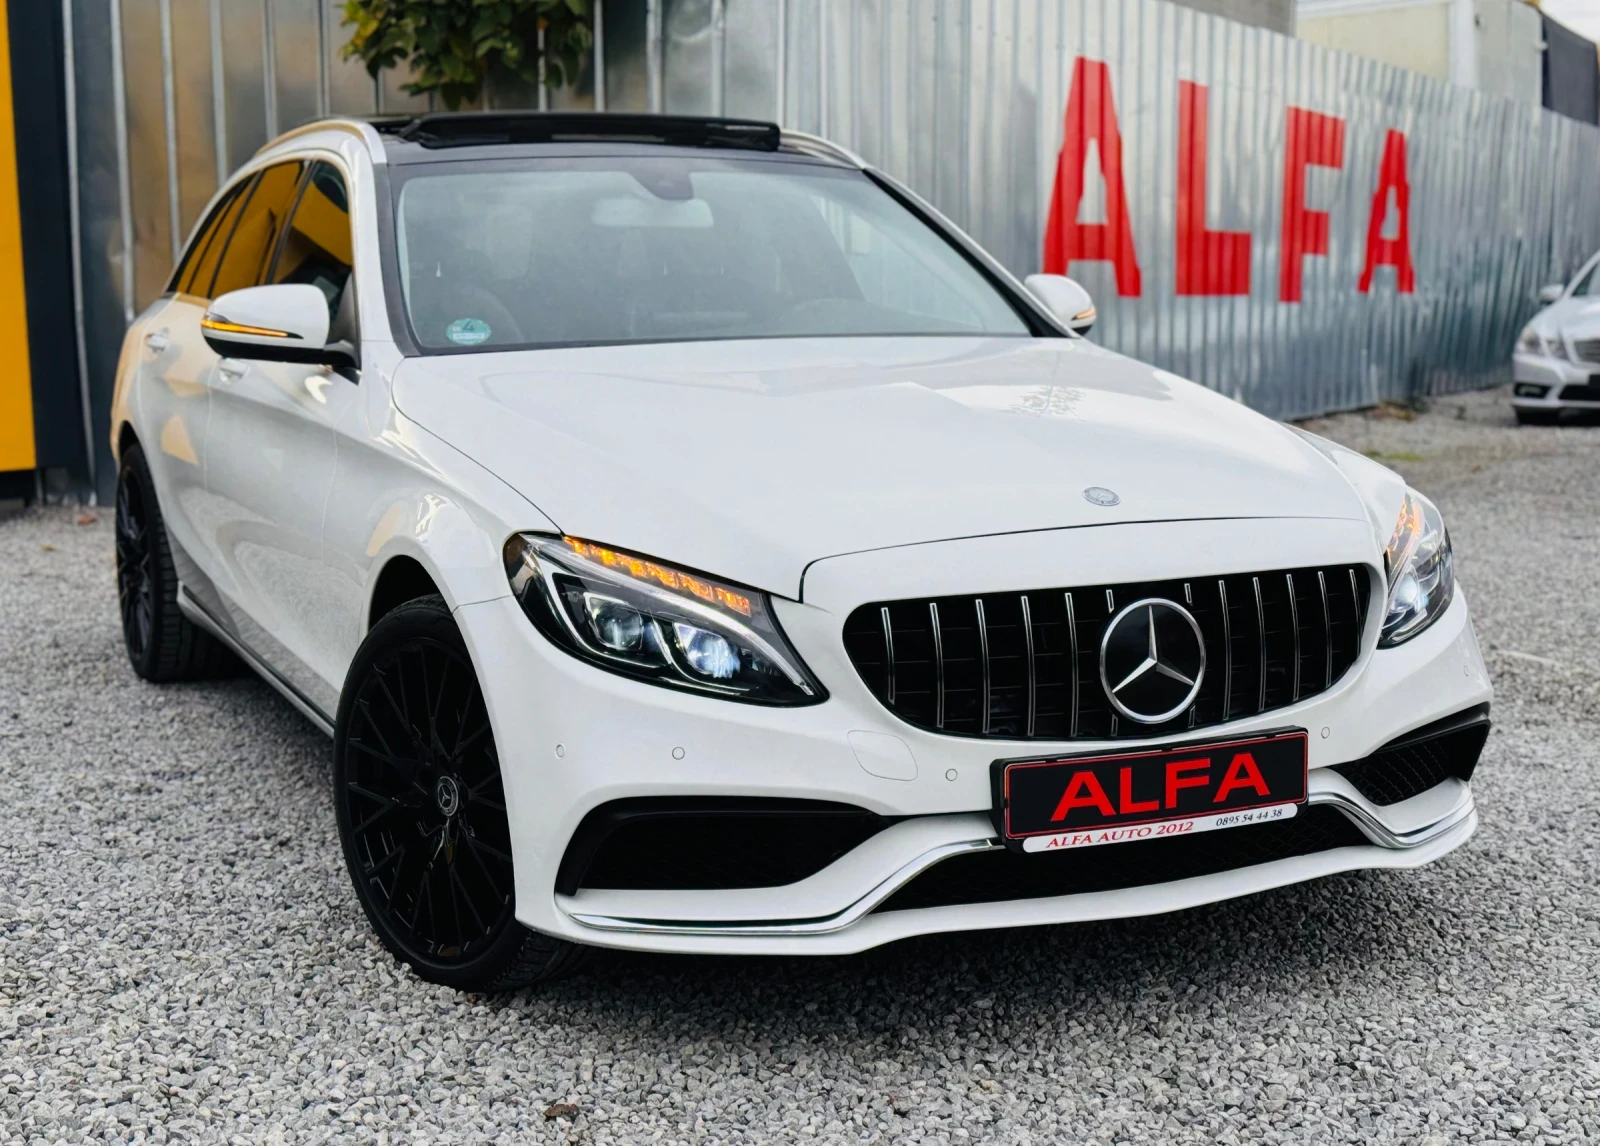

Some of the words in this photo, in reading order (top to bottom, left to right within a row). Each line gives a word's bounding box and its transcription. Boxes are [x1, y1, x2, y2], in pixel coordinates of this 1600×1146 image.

[1043, 56, 1415, 303] ALFA
[1050, 752, 1271, 822] ALFA
[1046, 833, 1092, 849] ALFA
[1096, 827, 1152, 843] AUTO
[1155, 821, 1194, 836] 2012
[1215, 815, 1241, 827] 0895
[1241, 813, 1254, 823] 54
[1256, 810, 1269, 820] 44
[1270, 808, 1283, 818] 38
